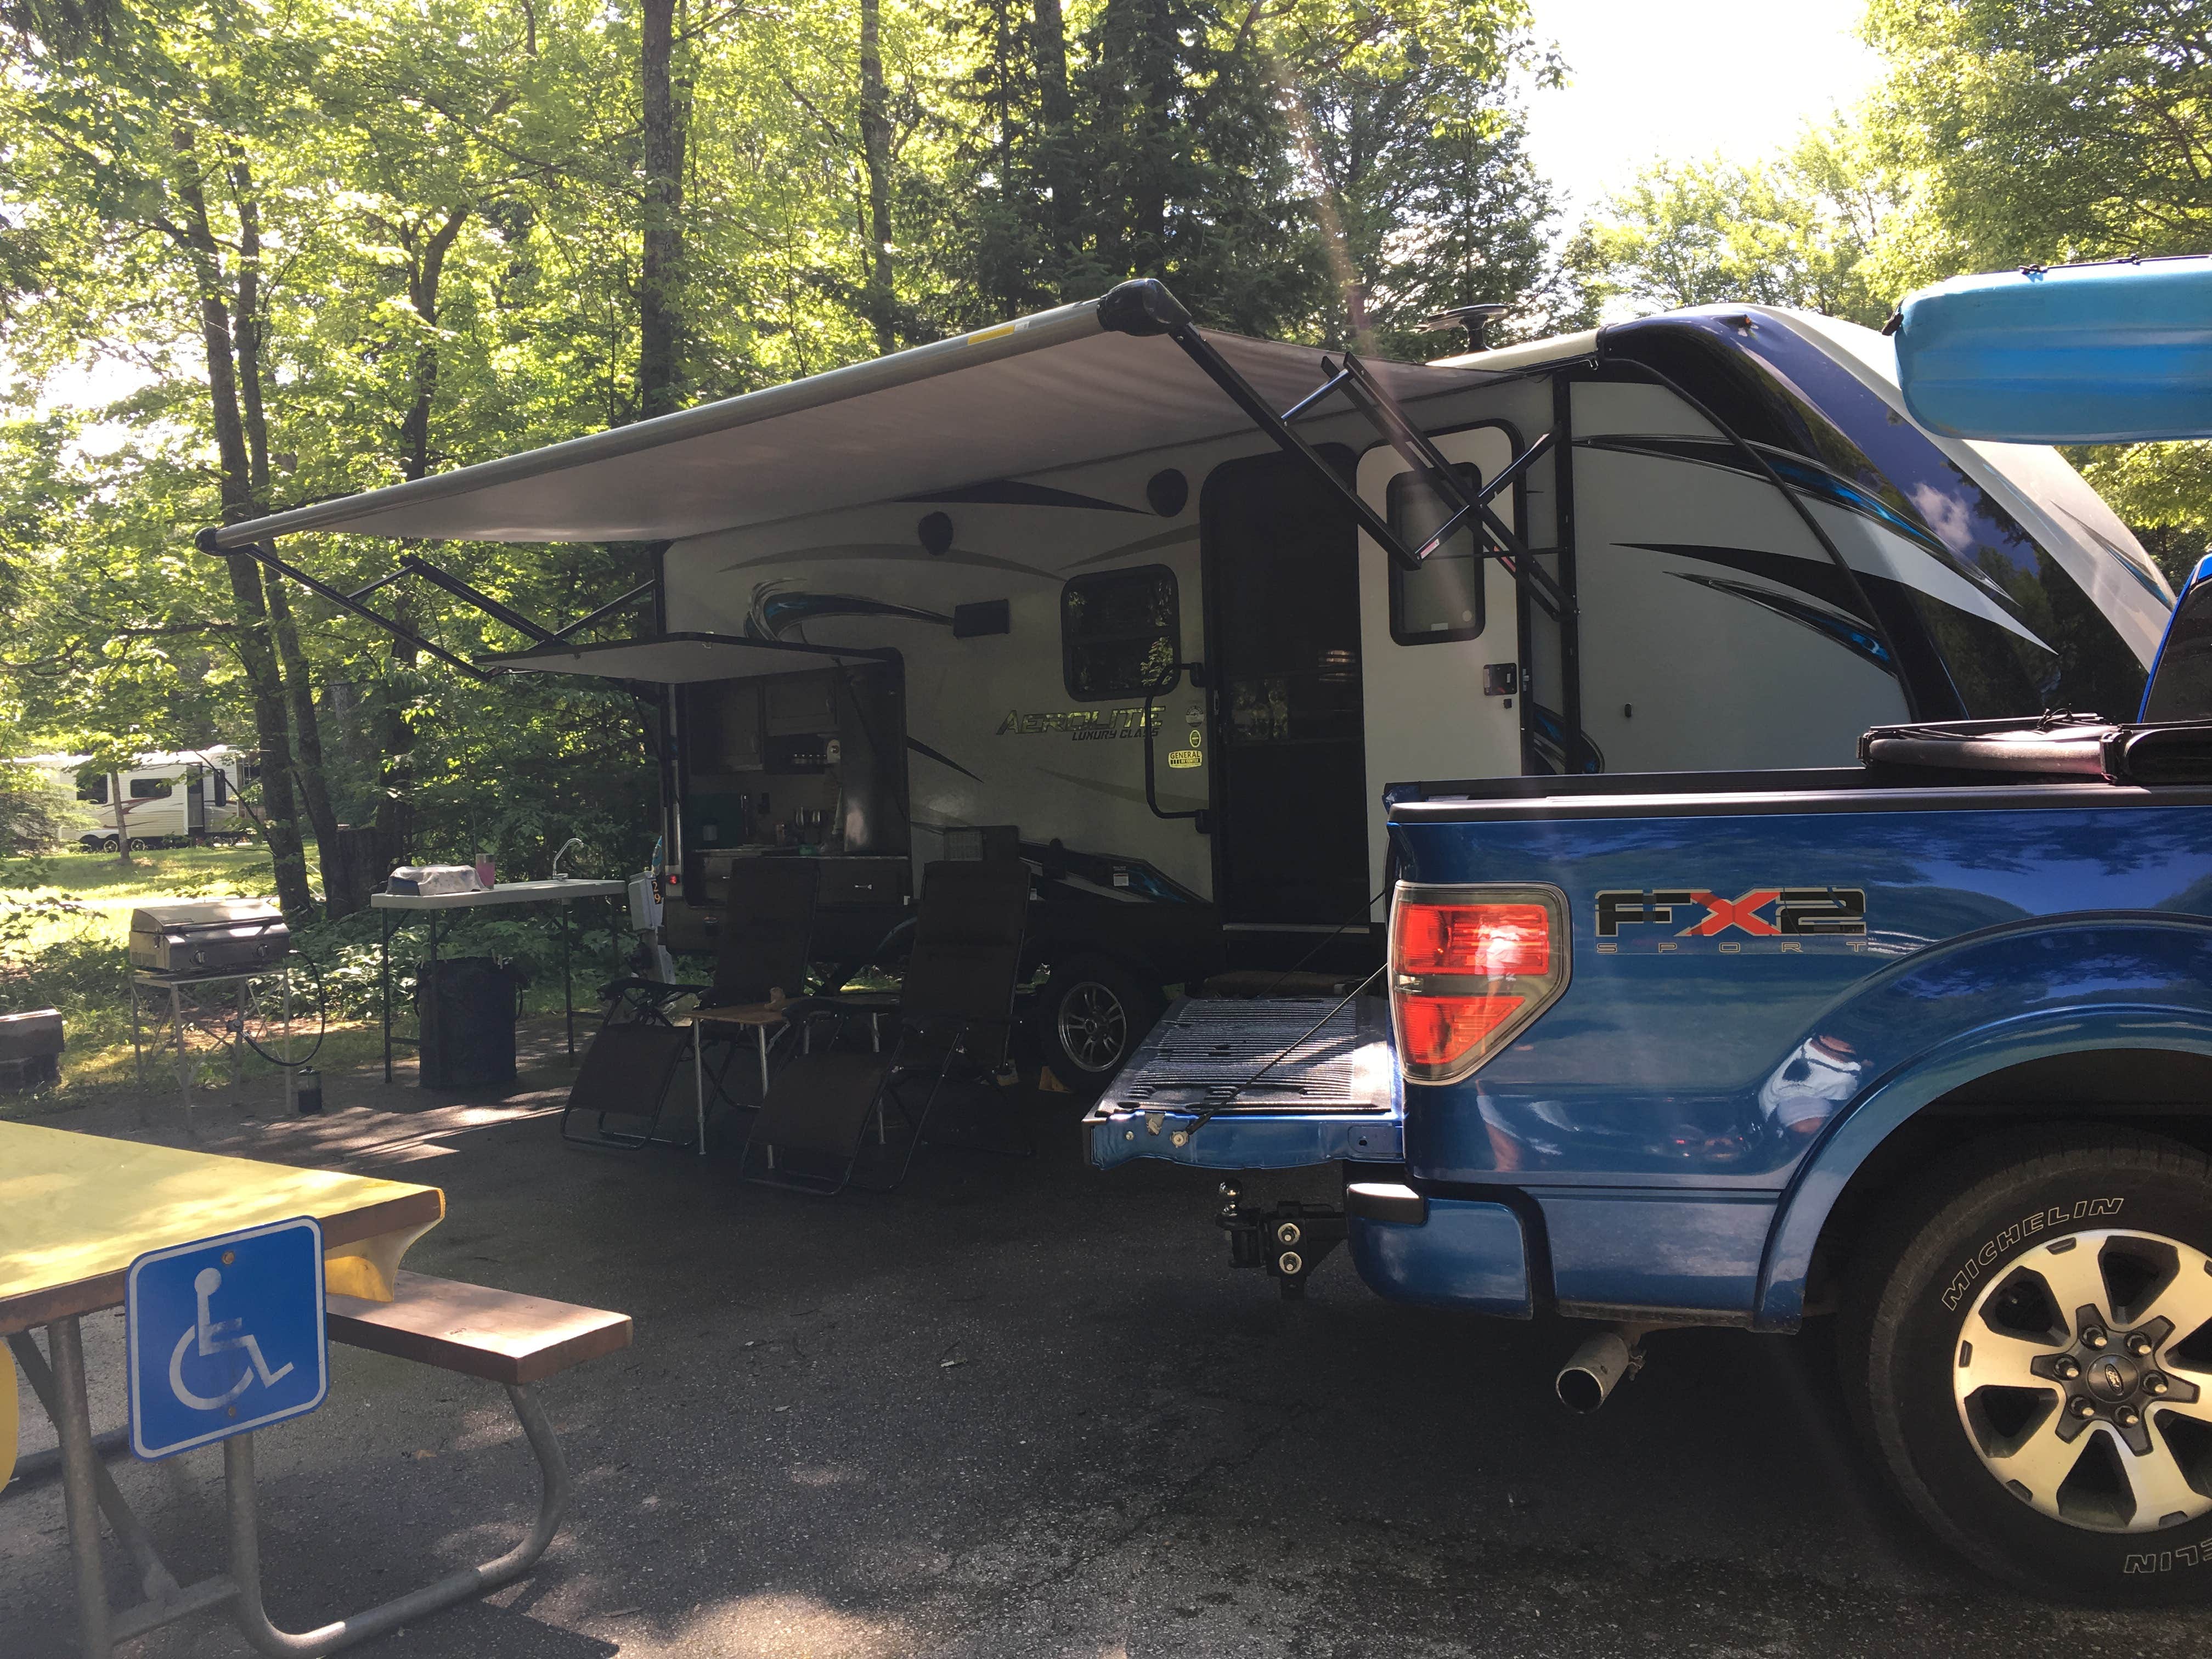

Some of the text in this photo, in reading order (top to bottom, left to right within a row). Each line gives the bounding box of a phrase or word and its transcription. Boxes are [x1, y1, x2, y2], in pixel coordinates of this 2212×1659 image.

[996, 707, 1166, 735] AEROLITE
[1071, 730, 1117, 741] LUXURY
[652, 882, 661, 903] 29
[1594, 887, 1866, 937] FX2
[1595, 941, 1866, 954] SPORT
[1941, 1198, 2124, 1312] MICHELIN
